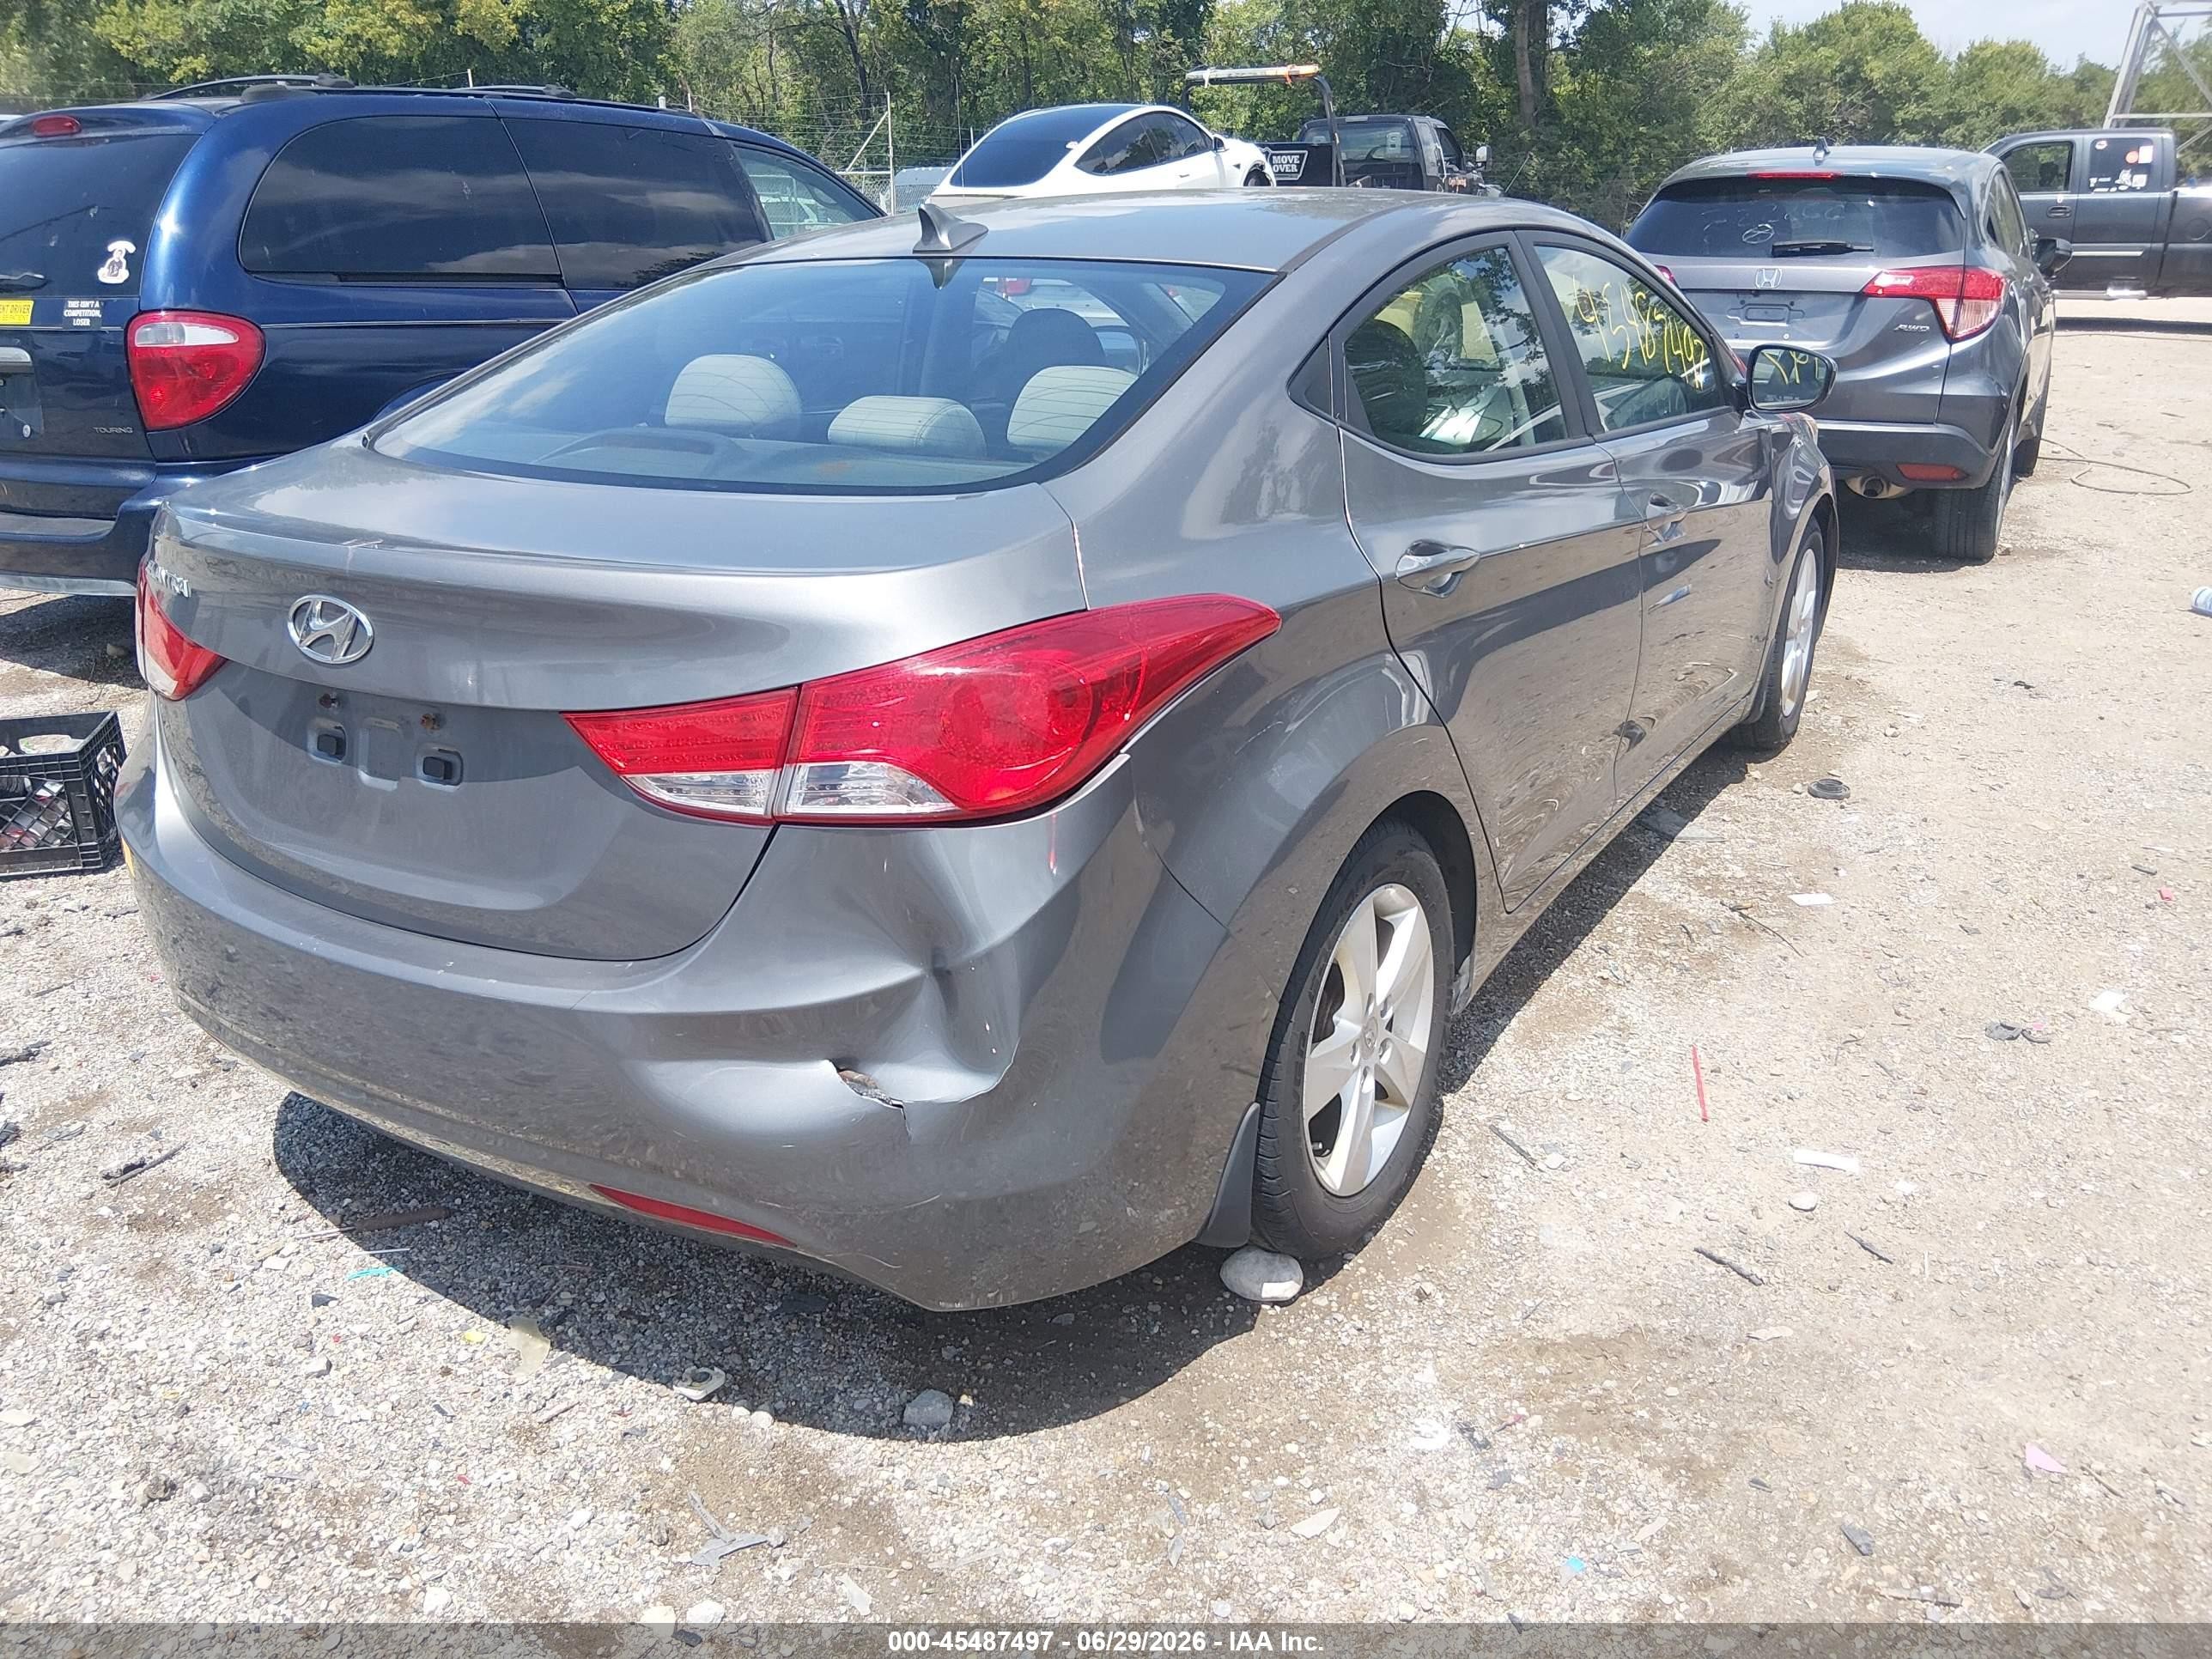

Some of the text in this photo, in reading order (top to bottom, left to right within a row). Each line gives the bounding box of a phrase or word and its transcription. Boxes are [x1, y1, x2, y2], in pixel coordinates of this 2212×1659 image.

[1272, 155, 1300, 164] MOVE
[1273, 164, 1298, 173] OVER
[10, 304, 31, 314] DRIVER
